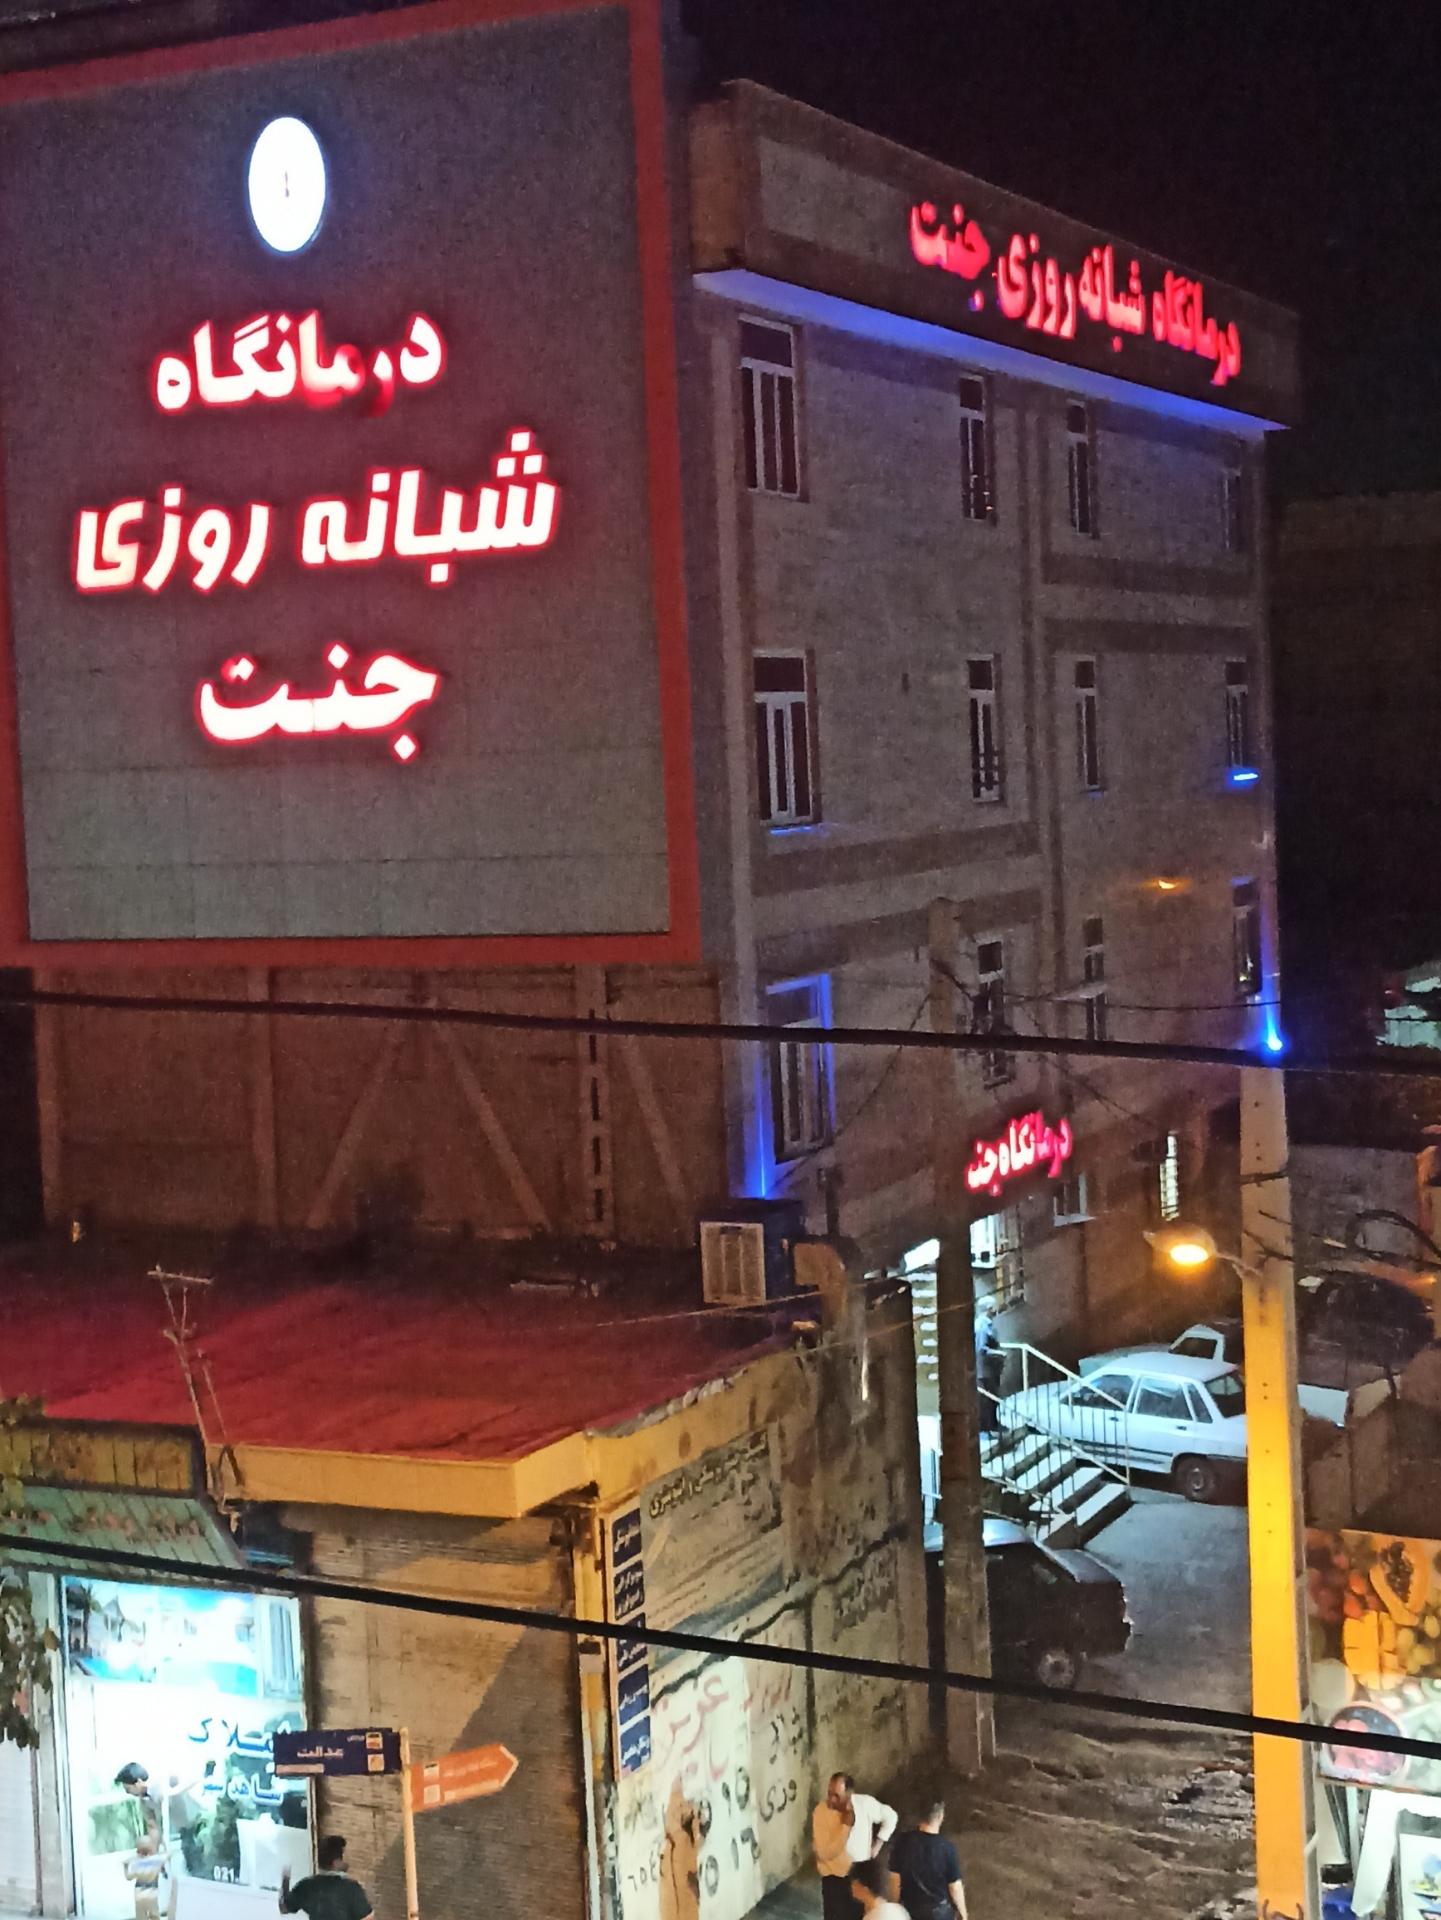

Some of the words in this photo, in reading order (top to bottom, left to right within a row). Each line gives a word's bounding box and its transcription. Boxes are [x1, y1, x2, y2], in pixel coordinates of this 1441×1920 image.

[908, 200, 991, 311] جنت
[997, 232, 1077, 340] روزی
[1079, 242, 1147, 353] شبانه
[155, 309, 448, 416] درمانگاه
[1152, 269, 1241, 387] درمانگاه
[73, 484, 272, 594] روزی
[300, 428, 561, 584] شبانه
[197, 640, 441, 762] جنت
